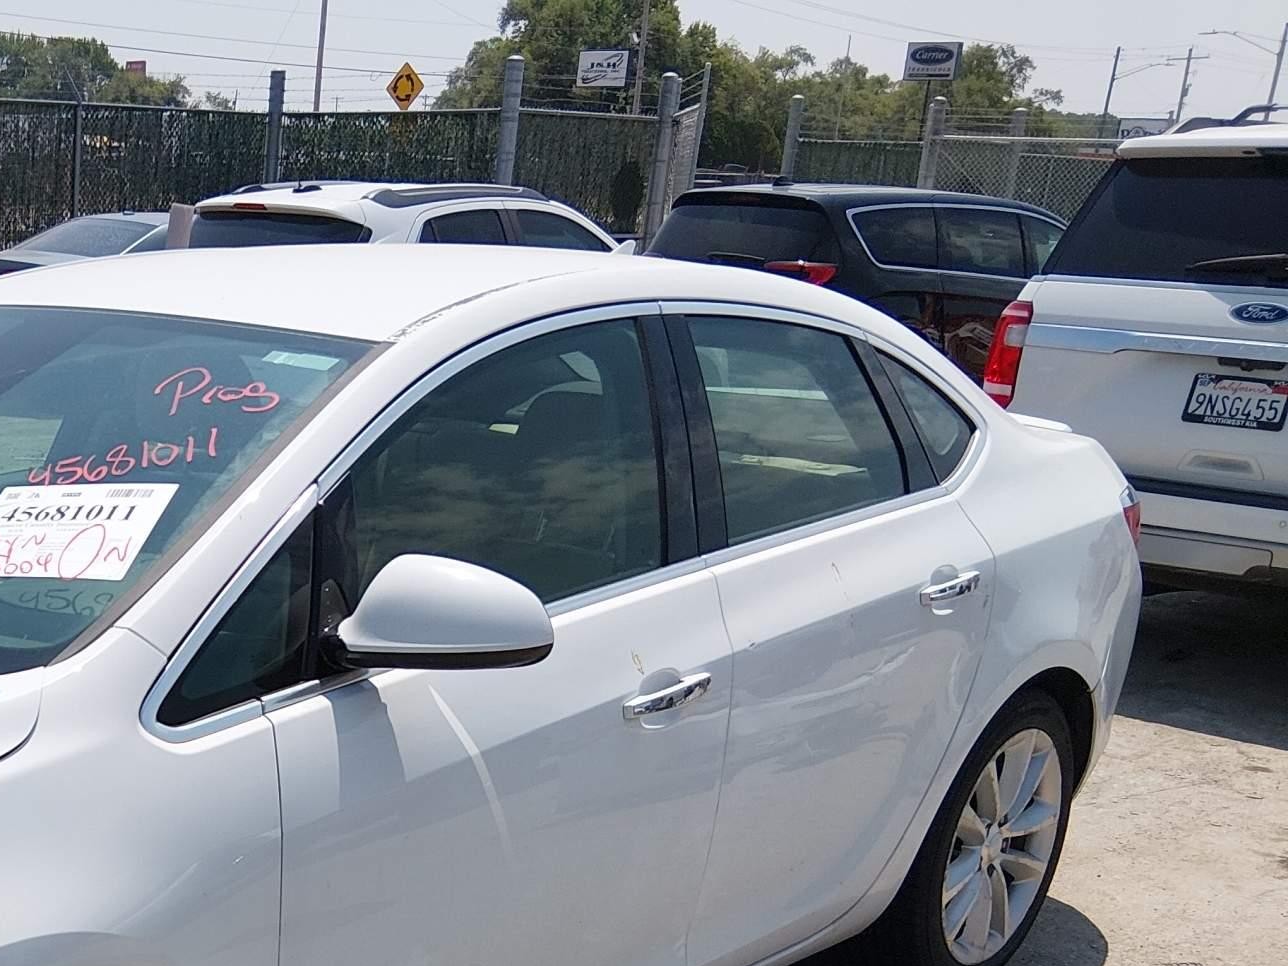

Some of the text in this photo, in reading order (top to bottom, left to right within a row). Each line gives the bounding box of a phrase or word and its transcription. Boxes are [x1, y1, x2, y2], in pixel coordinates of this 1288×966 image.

[1242, 304, 1281, 320] Ford
[1187, 392, 1281, 421] 9NSG455
[28, 427, 218, 486] 45681011
[0, 503, 137, 522] 45681011
